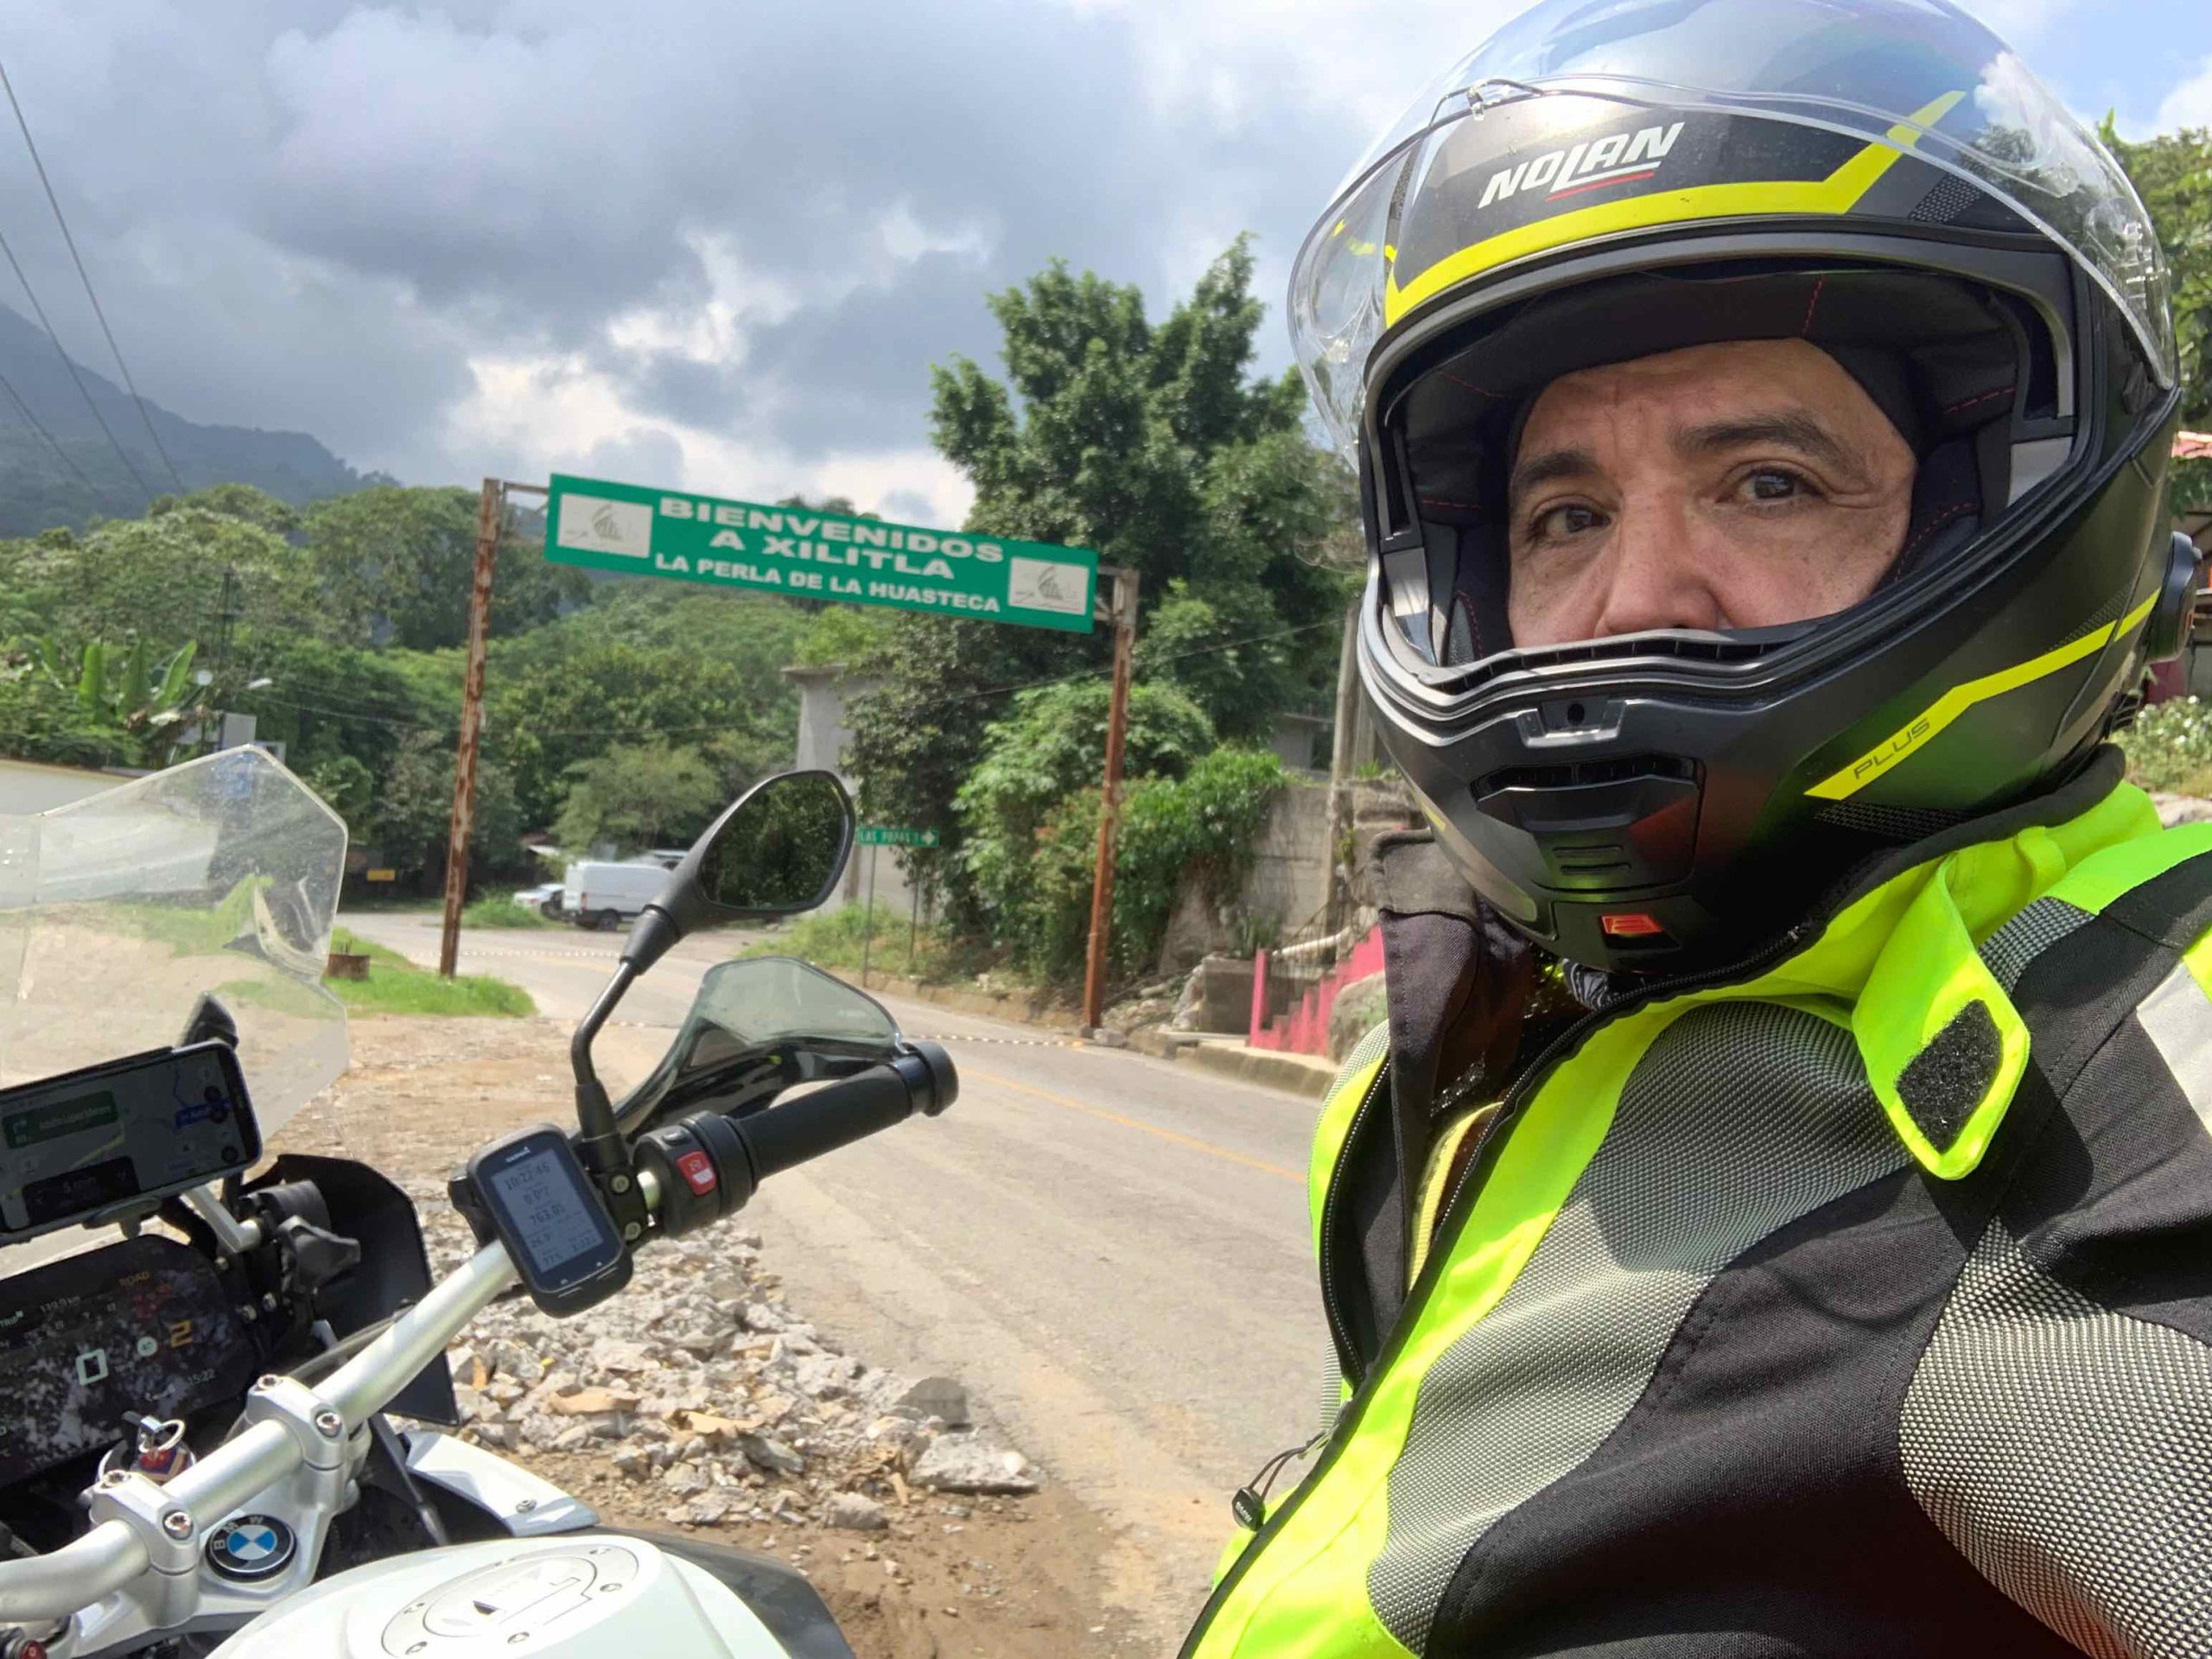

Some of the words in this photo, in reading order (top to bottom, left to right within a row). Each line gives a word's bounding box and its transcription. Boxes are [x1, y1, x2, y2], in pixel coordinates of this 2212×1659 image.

[1478, 122, 1685, 209] NOLAN
[659, 496, 1004, 563] BIENVENIDOS
[709, 529, 747, 550] A
[761, 535, 955, 580] XILITLA
[655, 553, 690, 572] LA
[696, 558, 782, 584] PERLA
[789, 569, 823, 589] DE
[830, 575, 862, 595] LA
[868, 581, 1001, 613] HUASTECA
[1853, 717, 1930, 780] PLUS
[170, 1320, 193, 1348] 2
[75, 1349, 109, 1386] 0
